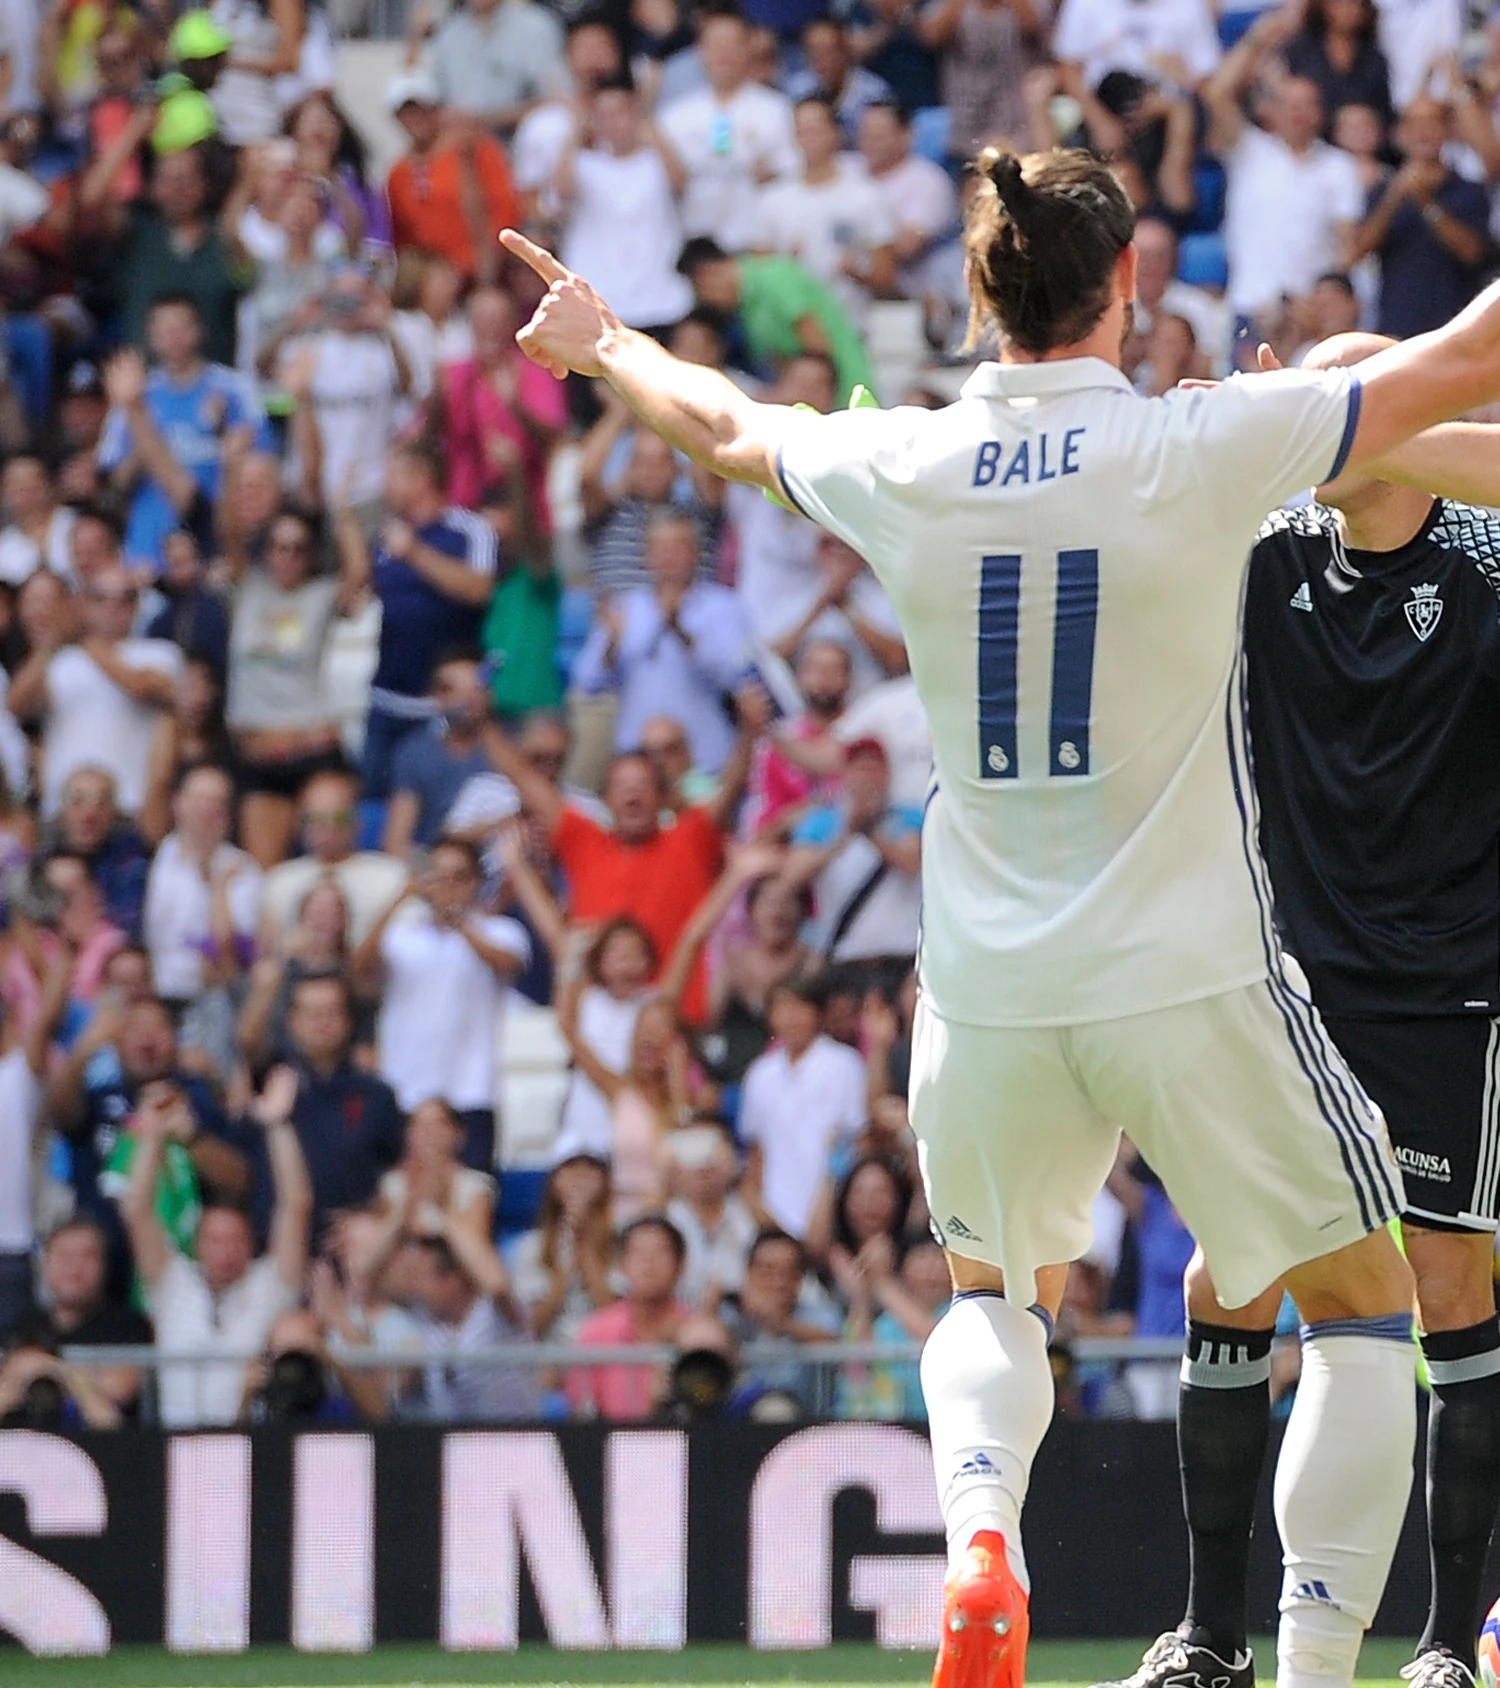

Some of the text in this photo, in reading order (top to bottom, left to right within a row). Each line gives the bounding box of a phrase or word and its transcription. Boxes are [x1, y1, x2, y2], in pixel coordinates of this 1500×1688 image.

[971, 428, 1087, 488] BALE
[977, 548, 1100, 779] 11
[1394, 1145, 1451, 1174] ACUNSA
